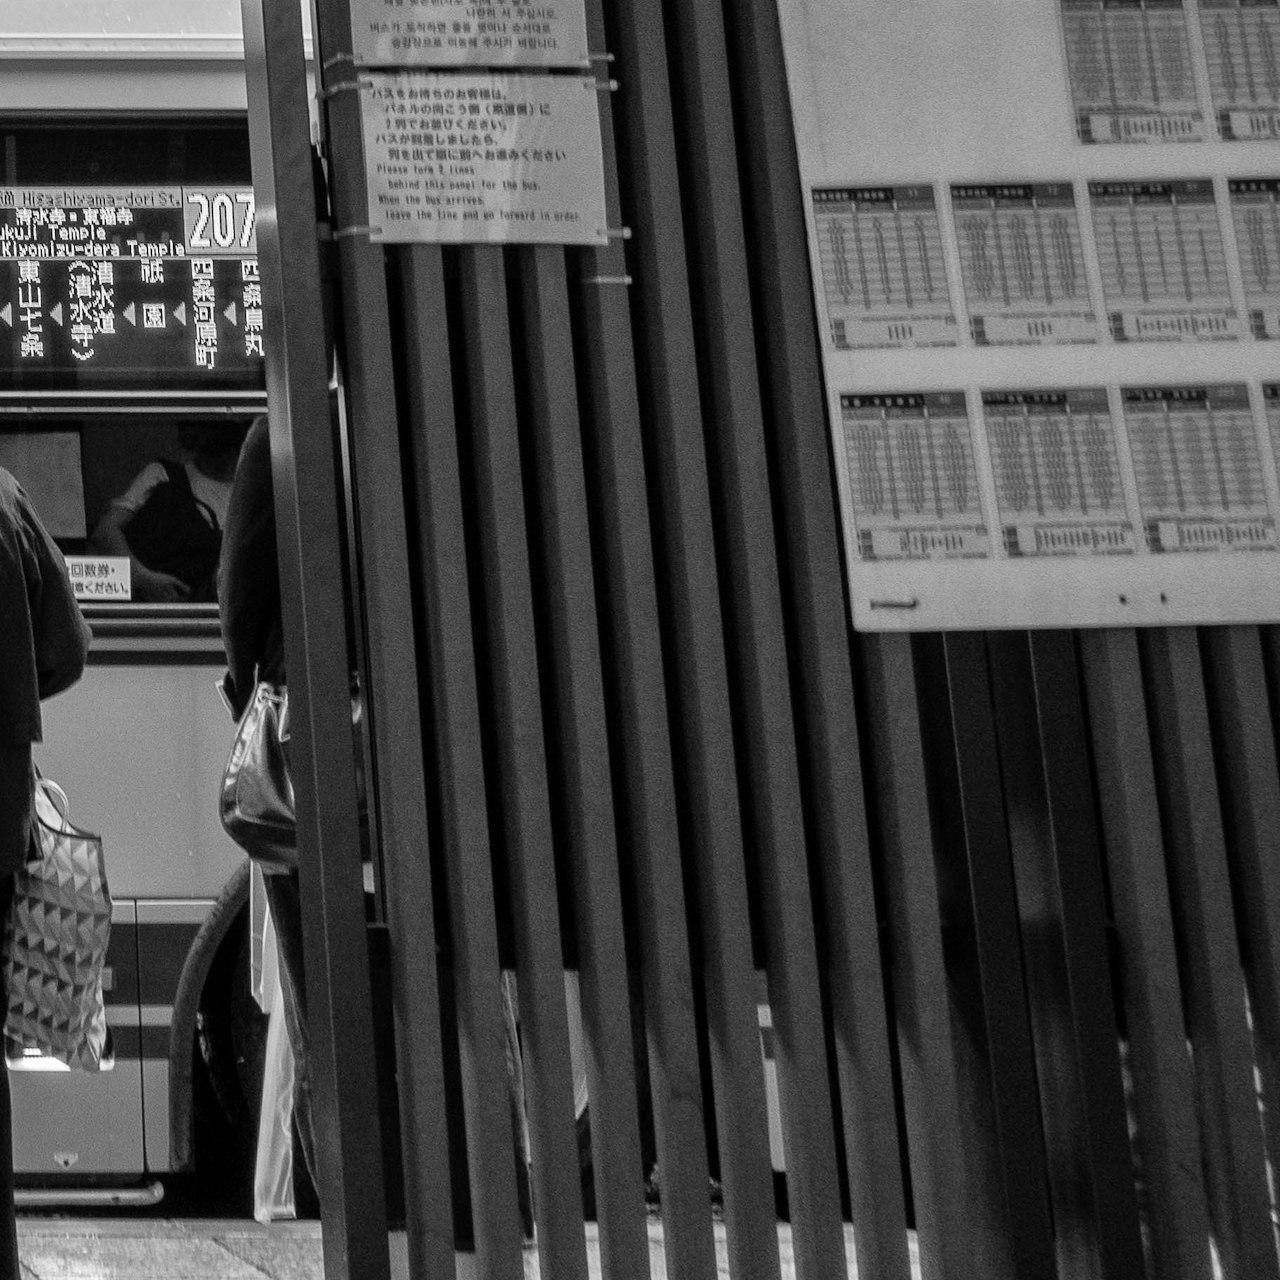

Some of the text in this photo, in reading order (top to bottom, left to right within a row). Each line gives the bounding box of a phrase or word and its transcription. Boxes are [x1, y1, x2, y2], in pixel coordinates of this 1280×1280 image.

[376, 164, 409, 176] Please
[412, 164, 435, 176] form
[448, 164, 476, 176] lines
[387, 179, 421, 192] behind
[424, 179, 446, 192] this
[448, 180, 476, 193] panel
[481, 179, 497, 191] for
[502, 180, 519, 191] the
[377, 194, 401, 206] When
[405, 194, 421, 206] the
[425, 194, 441, 206] bus
[187, 192, 256, 249] 207
[416, 209, 433, 221] the
[461, 210, 480, 221] and
[499, 210, 536, 222] forward
[48, 223, 107, 241] Temple
[127, 241, 186, 257] Temple
